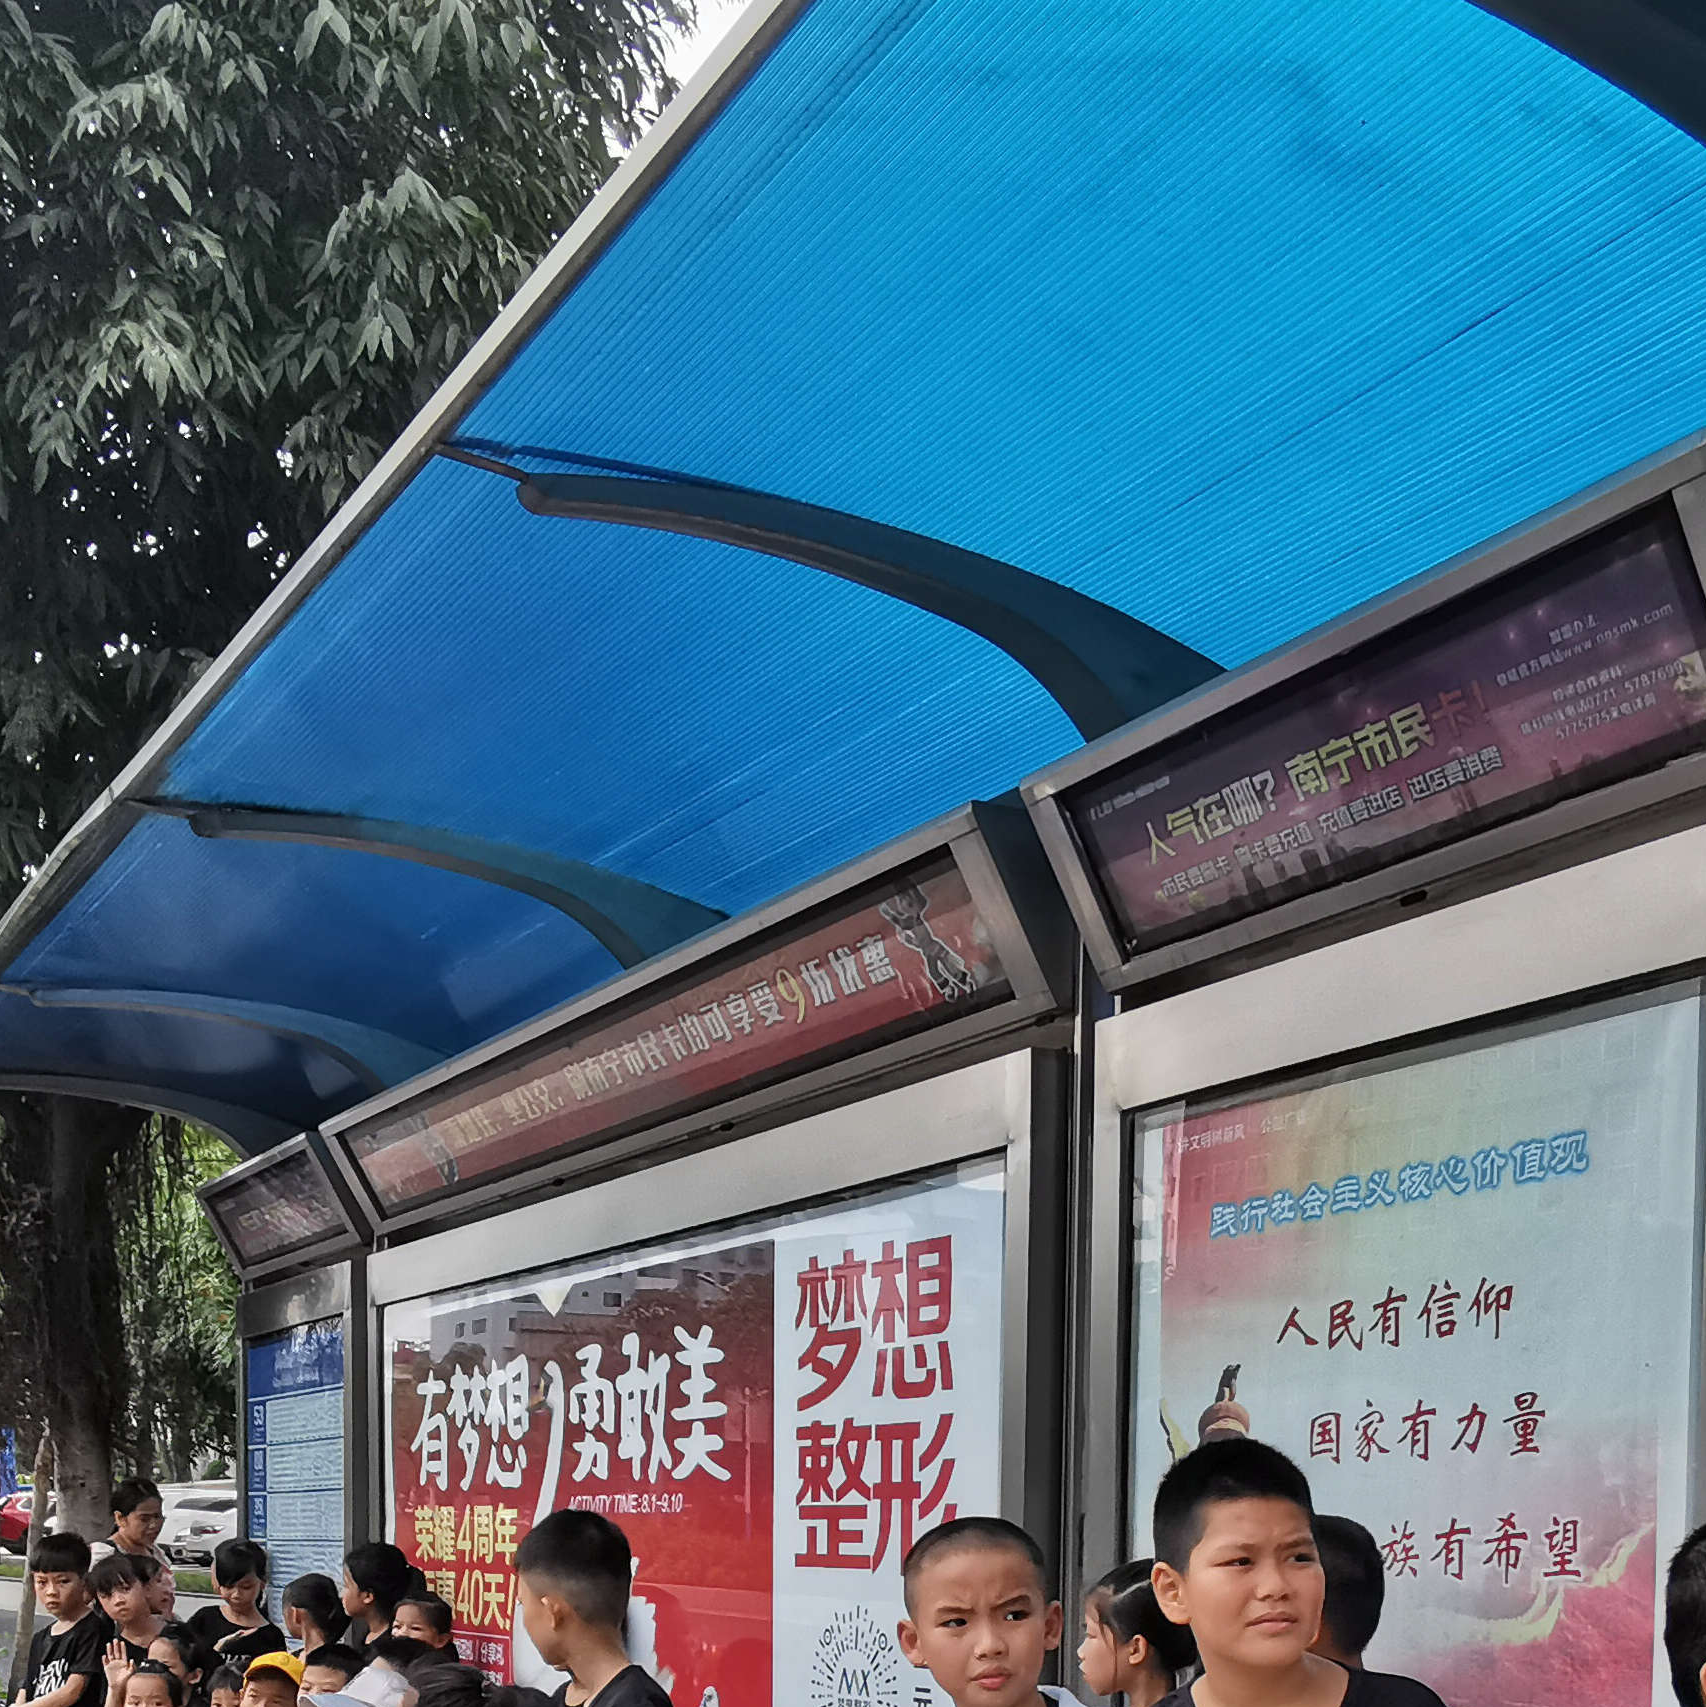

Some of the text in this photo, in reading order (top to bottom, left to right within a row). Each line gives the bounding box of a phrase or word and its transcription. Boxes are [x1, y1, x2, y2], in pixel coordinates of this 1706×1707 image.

[1209, 1130, 1591, 1239] 践行社会主义核心价值观
[796, 1234, 954, 1412] 梦想
[1276, 1276, 1515, 1350] 人民有信仰
[1307, 1391, 1549, 1465] 国家有力量
[794, 1411, 957, 1574] 整形
